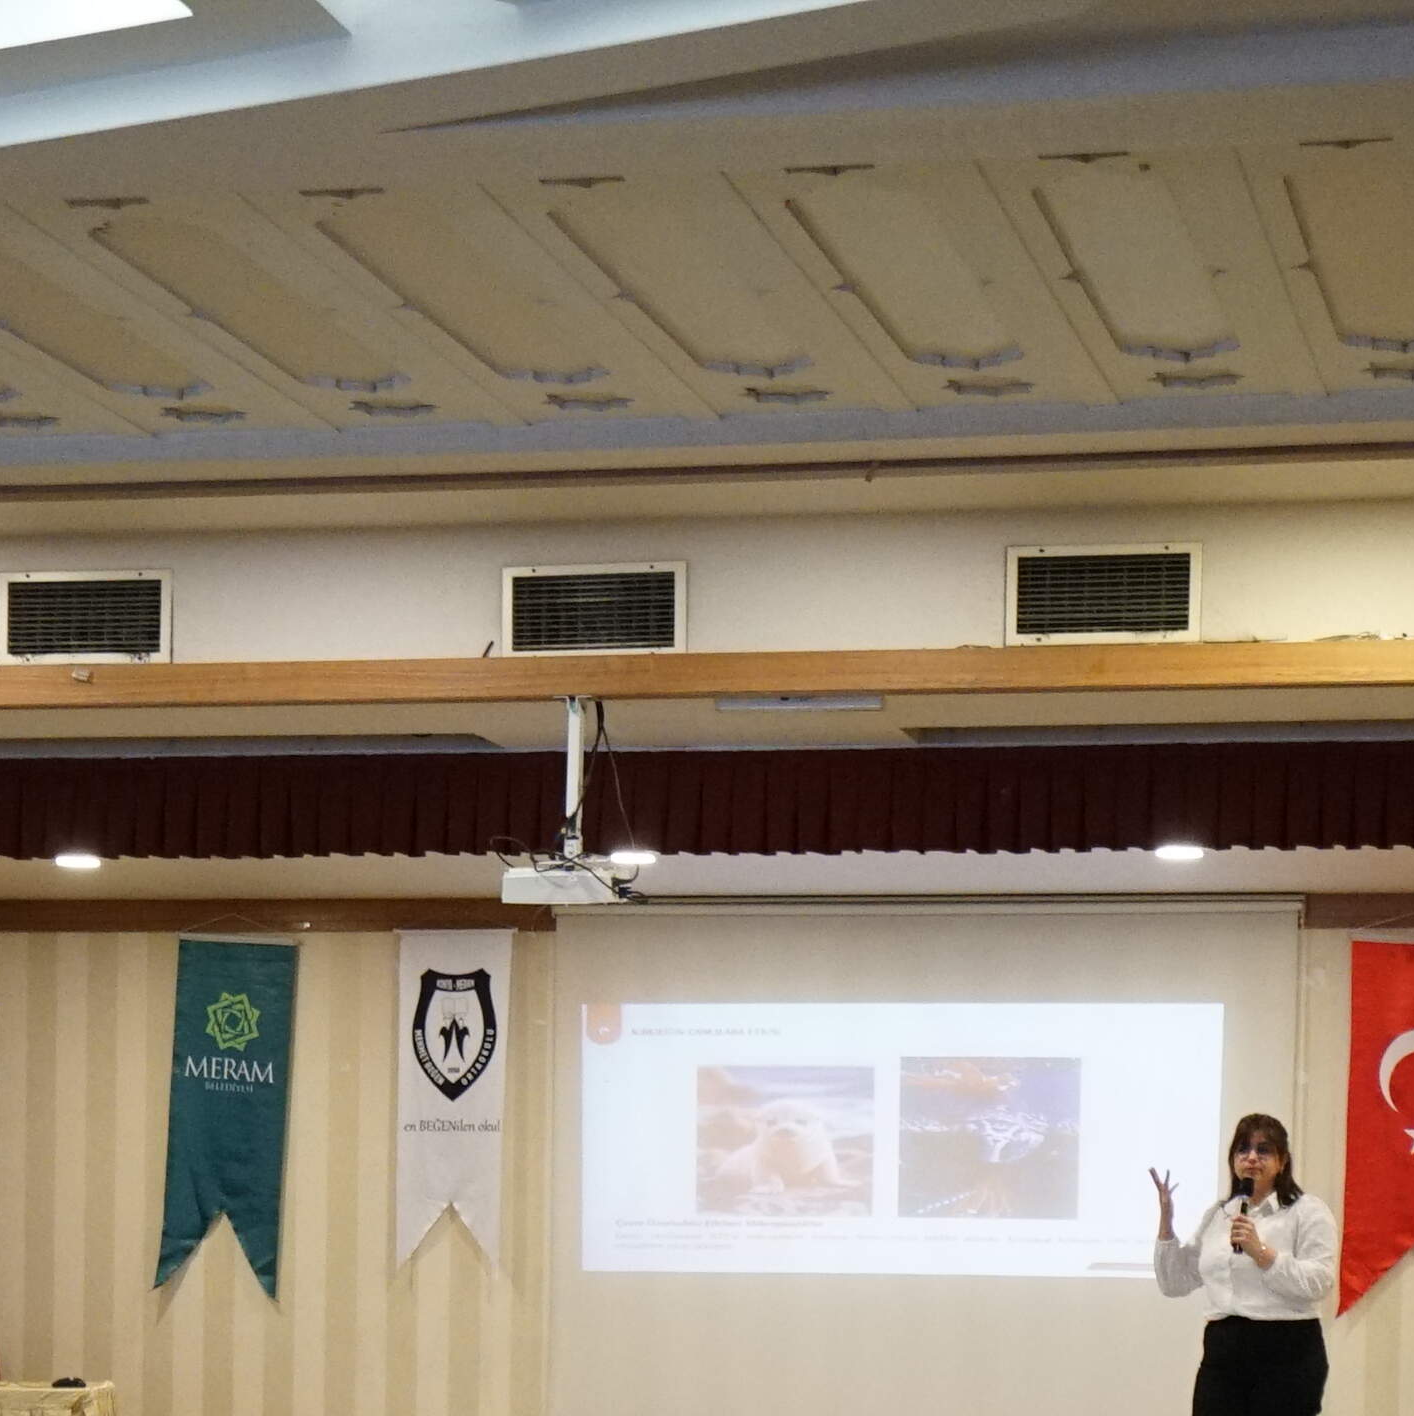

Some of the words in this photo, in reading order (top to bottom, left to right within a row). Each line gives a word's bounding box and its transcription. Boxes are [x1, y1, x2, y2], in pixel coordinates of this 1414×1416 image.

[184, 1055, 274, 1084] MERAM
[403, 1121, 416, 1132] en
[478, 1120, 501, 1132] okul
